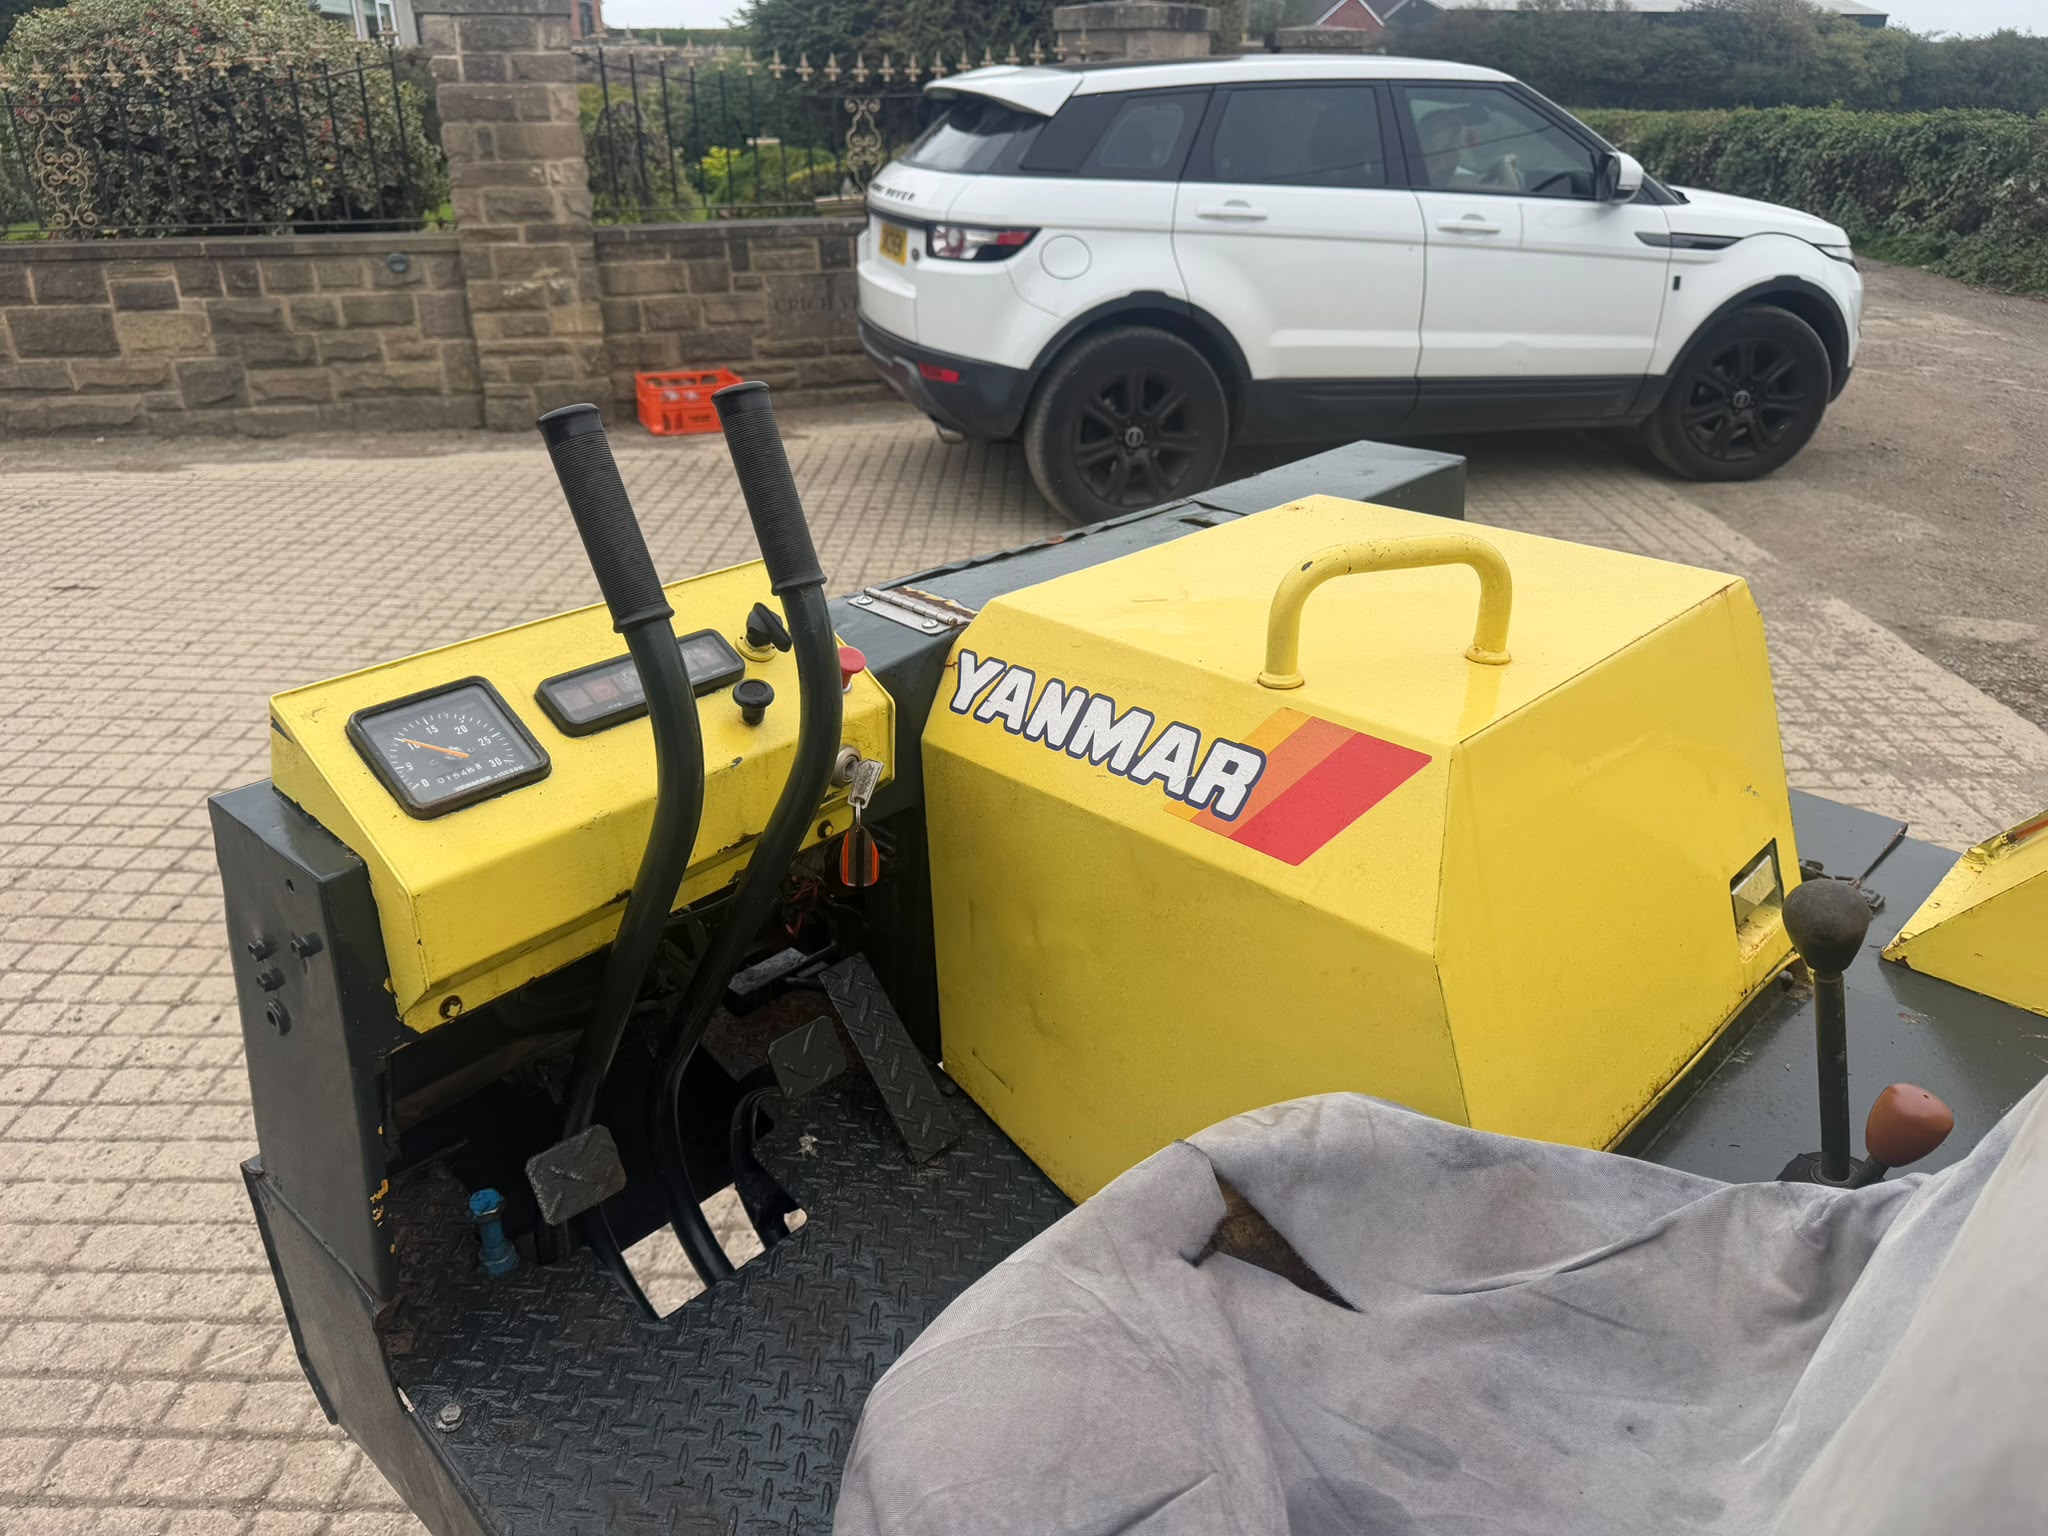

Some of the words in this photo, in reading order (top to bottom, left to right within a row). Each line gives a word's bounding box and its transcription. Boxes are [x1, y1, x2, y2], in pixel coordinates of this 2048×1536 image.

[425, 725, 439, 735] 15
[454, 725, 469, 735] 20
[949, 648, 1267, 822] YANMAR
[478, 736, 492, 747] 25
[489, 757, 503, 768] 30
[421, 779, 430, 788] 0
